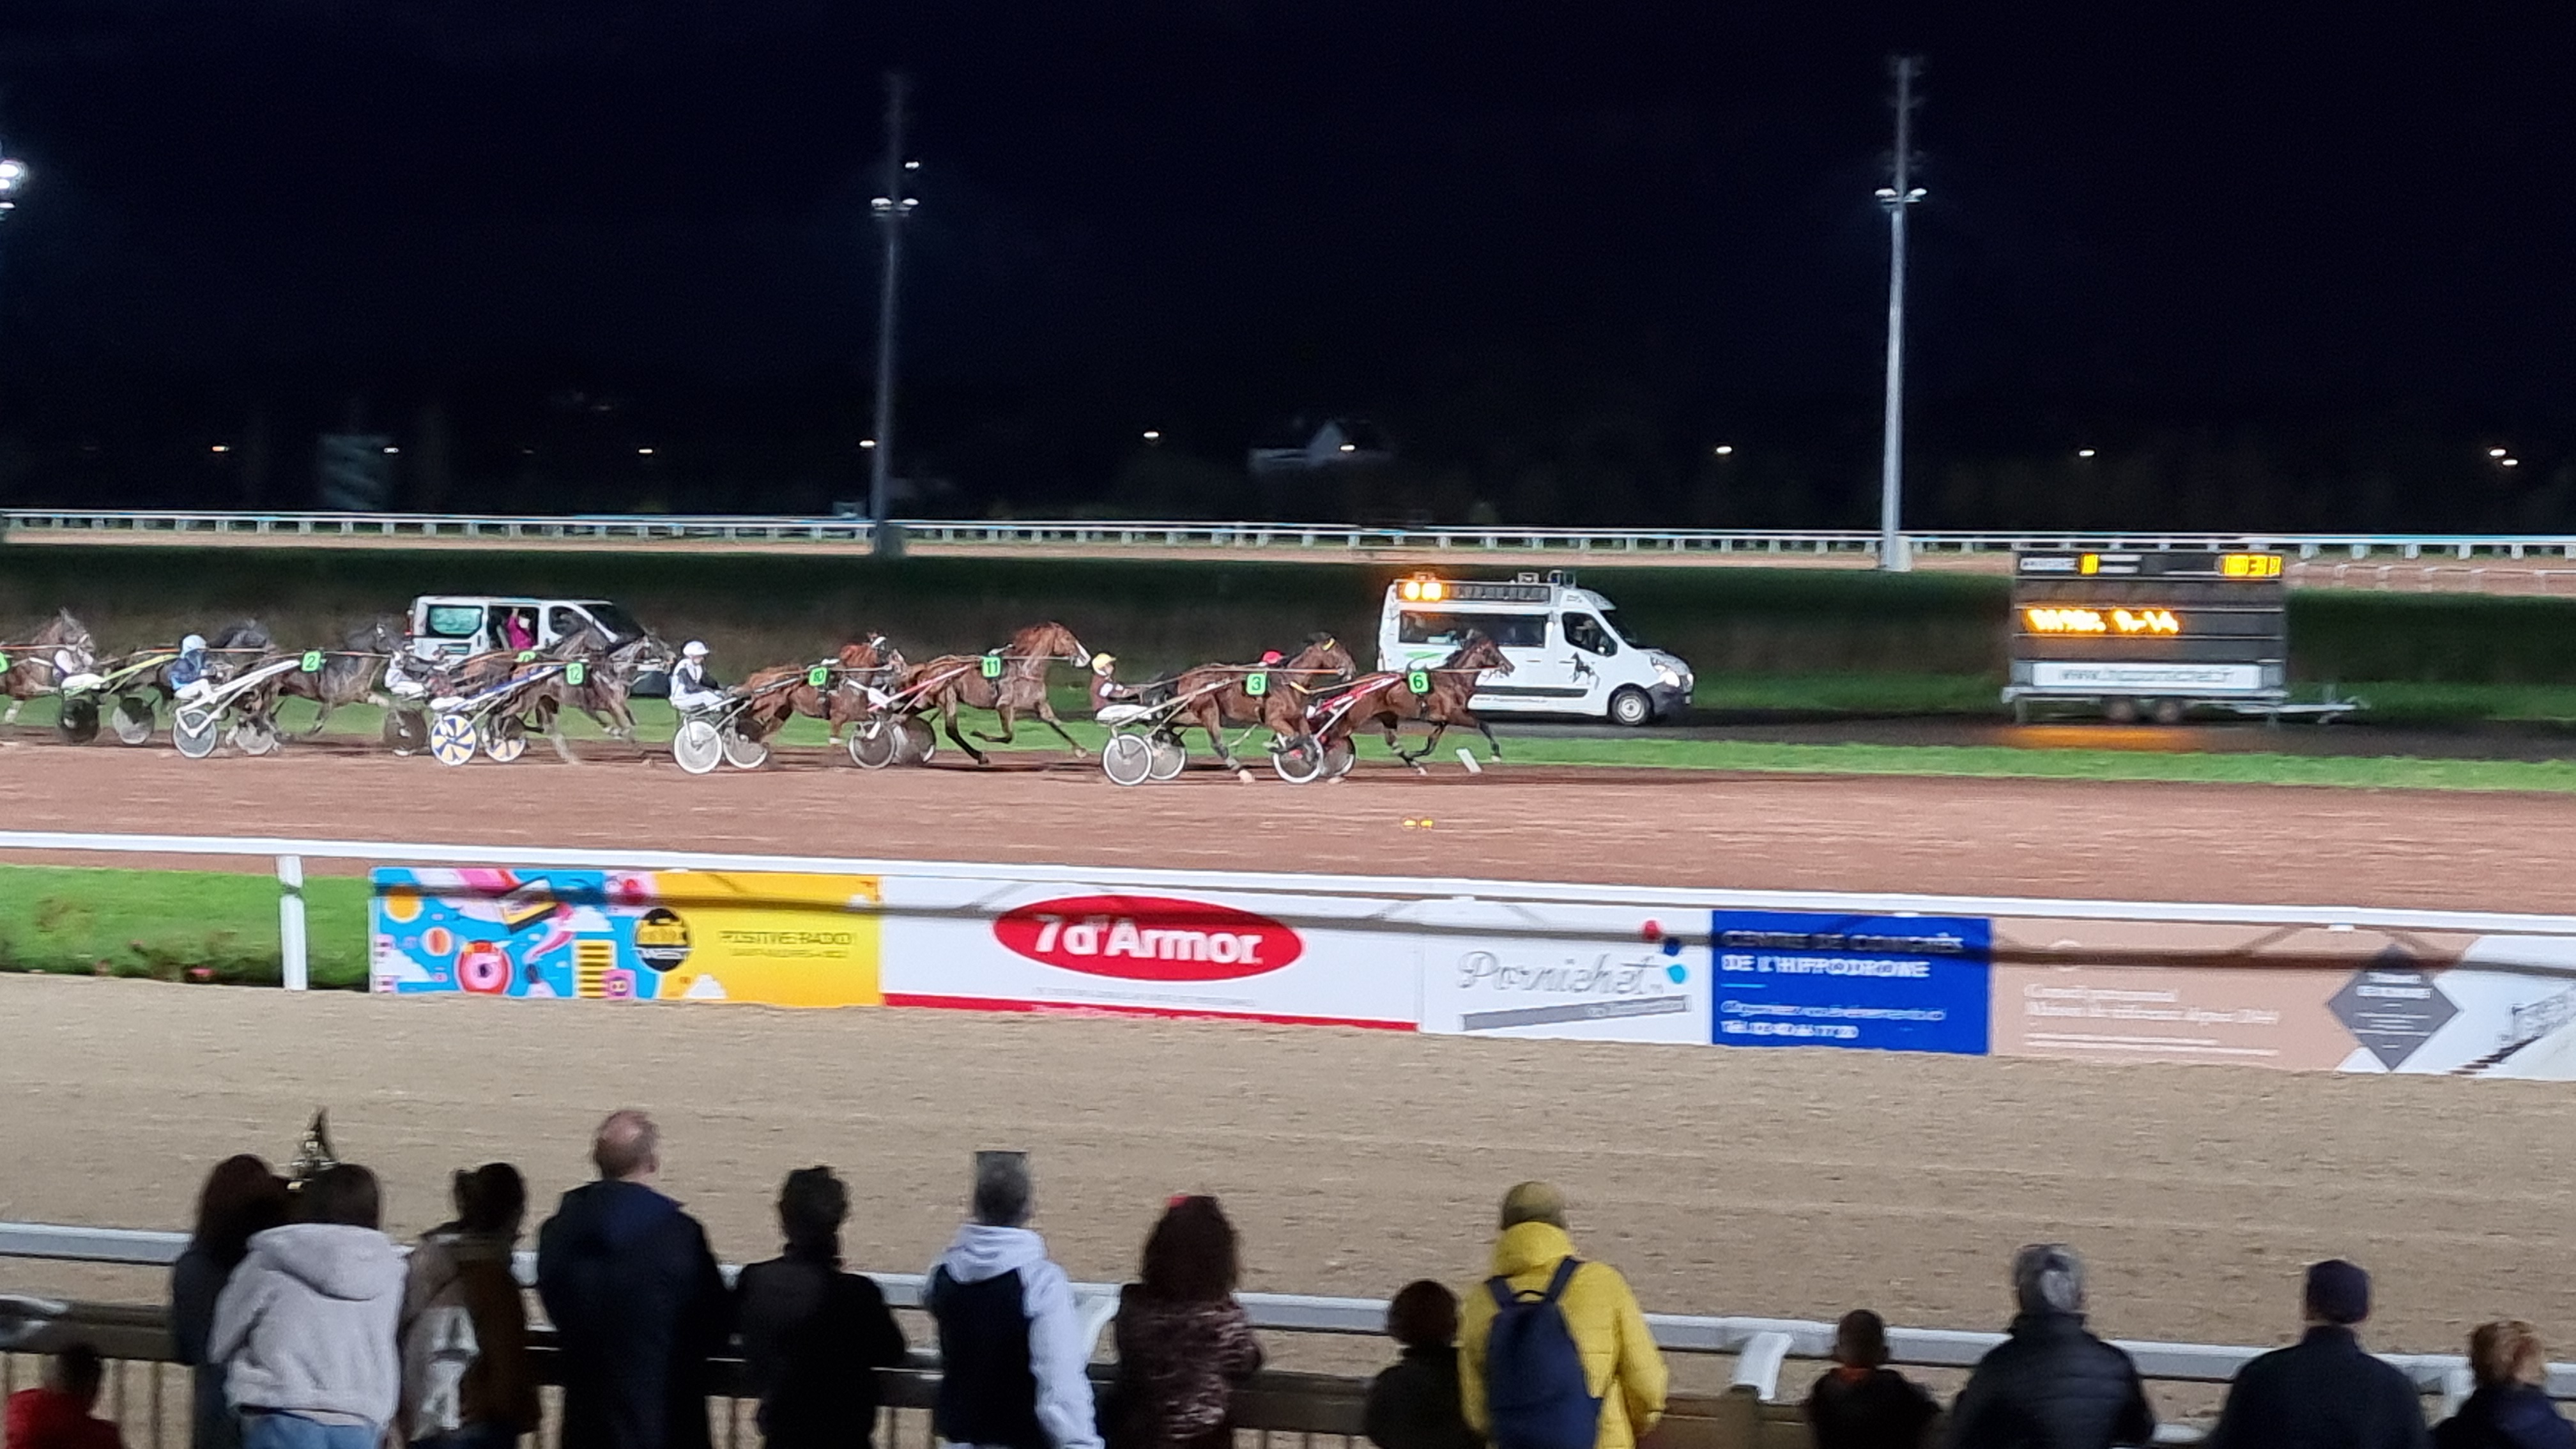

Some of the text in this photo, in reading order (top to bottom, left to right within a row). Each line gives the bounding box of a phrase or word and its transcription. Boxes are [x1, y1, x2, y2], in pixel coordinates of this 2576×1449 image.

[986, 660, 998, 675] 11
[1252, 676, 1262, 691] 3
[1413, 674, 1424, 689] 6
[1034, 914, 1066, 953] 7
[1457, 950, 1660, 995] Pornichet
[1721, 954, 1931, 977] DE L'HIPPODROME
